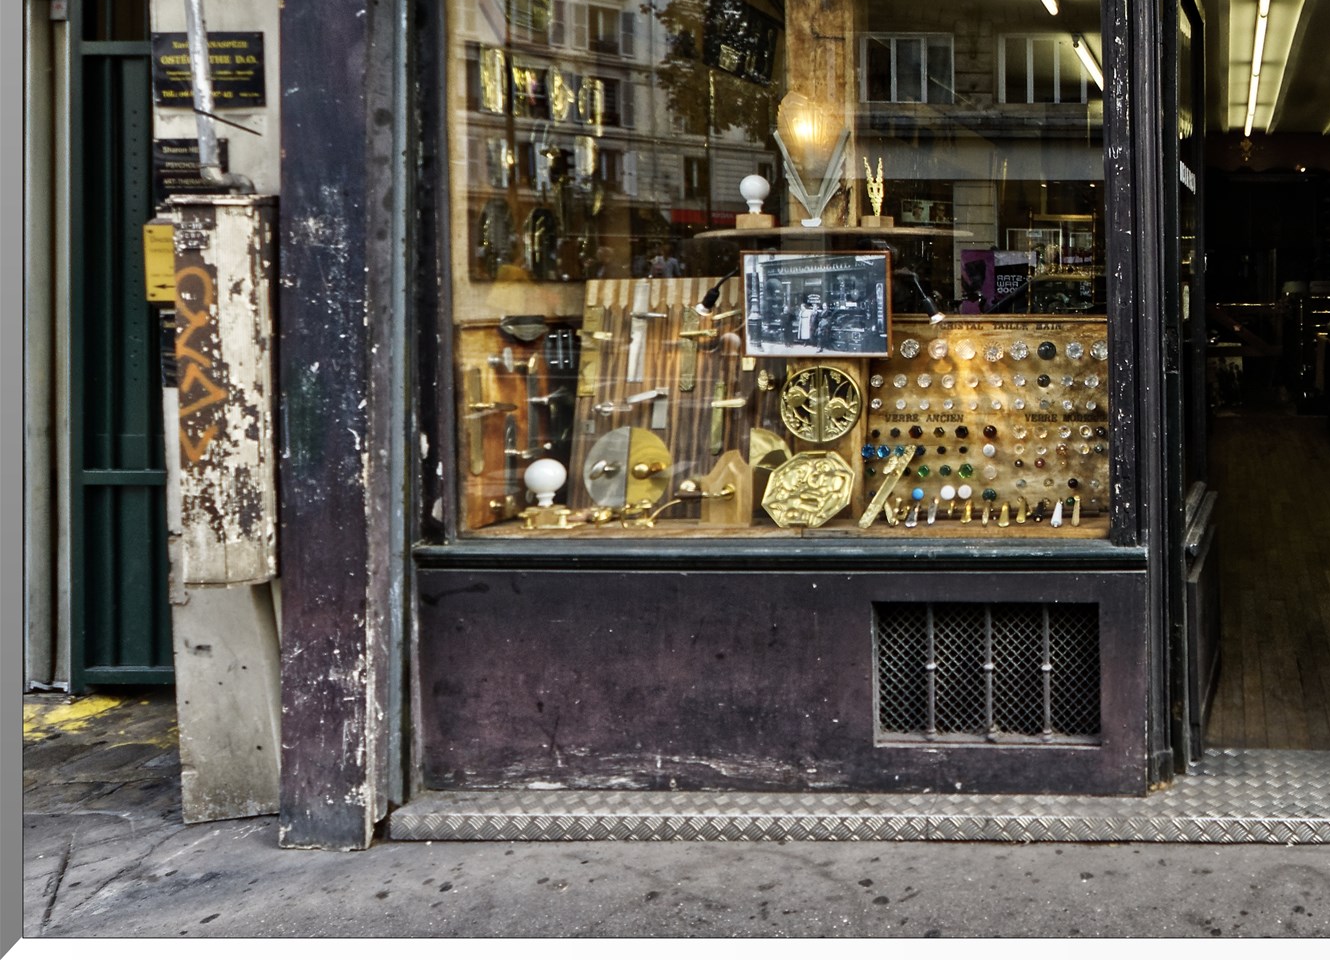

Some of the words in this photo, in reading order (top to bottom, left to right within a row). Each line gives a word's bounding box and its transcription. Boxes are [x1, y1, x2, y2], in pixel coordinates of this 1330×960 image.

[884, 414, 920, 423] VERRE
[926, 414, 964, 423] ANCIEN
[1024, 414, 1058, 423] VERRE
